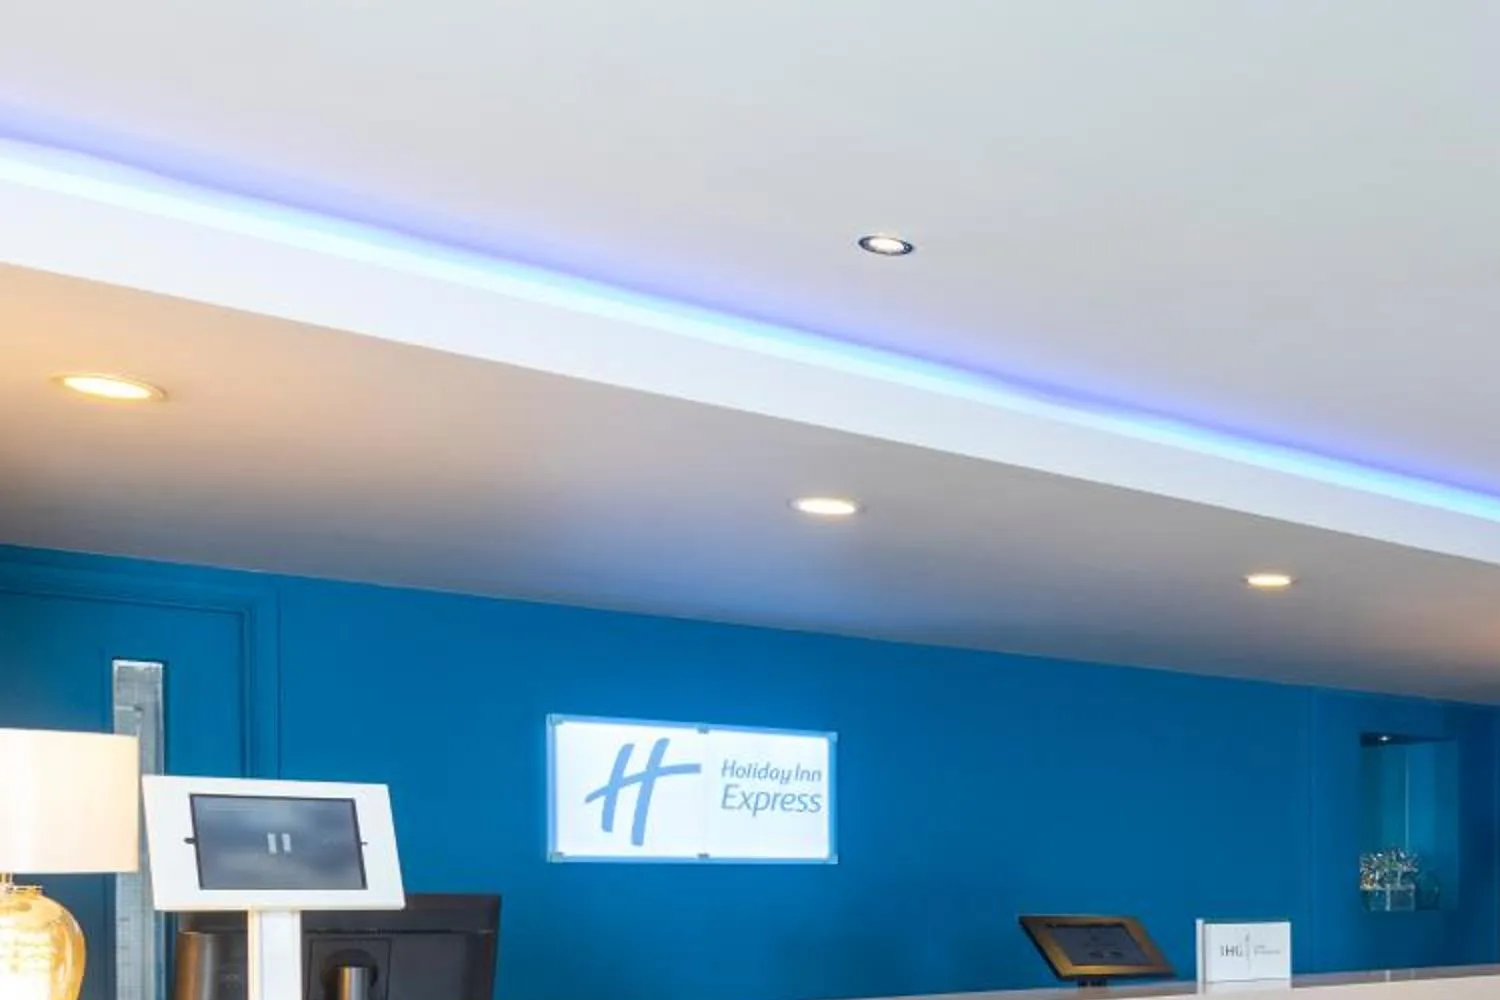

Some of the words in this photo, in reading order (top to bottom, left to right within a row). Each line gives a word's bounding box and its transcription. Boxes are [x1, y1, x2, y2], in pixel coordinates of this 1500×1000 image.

[721, 759, 792, 784] Holiday
[795, 763, 822, 782] Inn
[721, 783, 822, 817] Express
